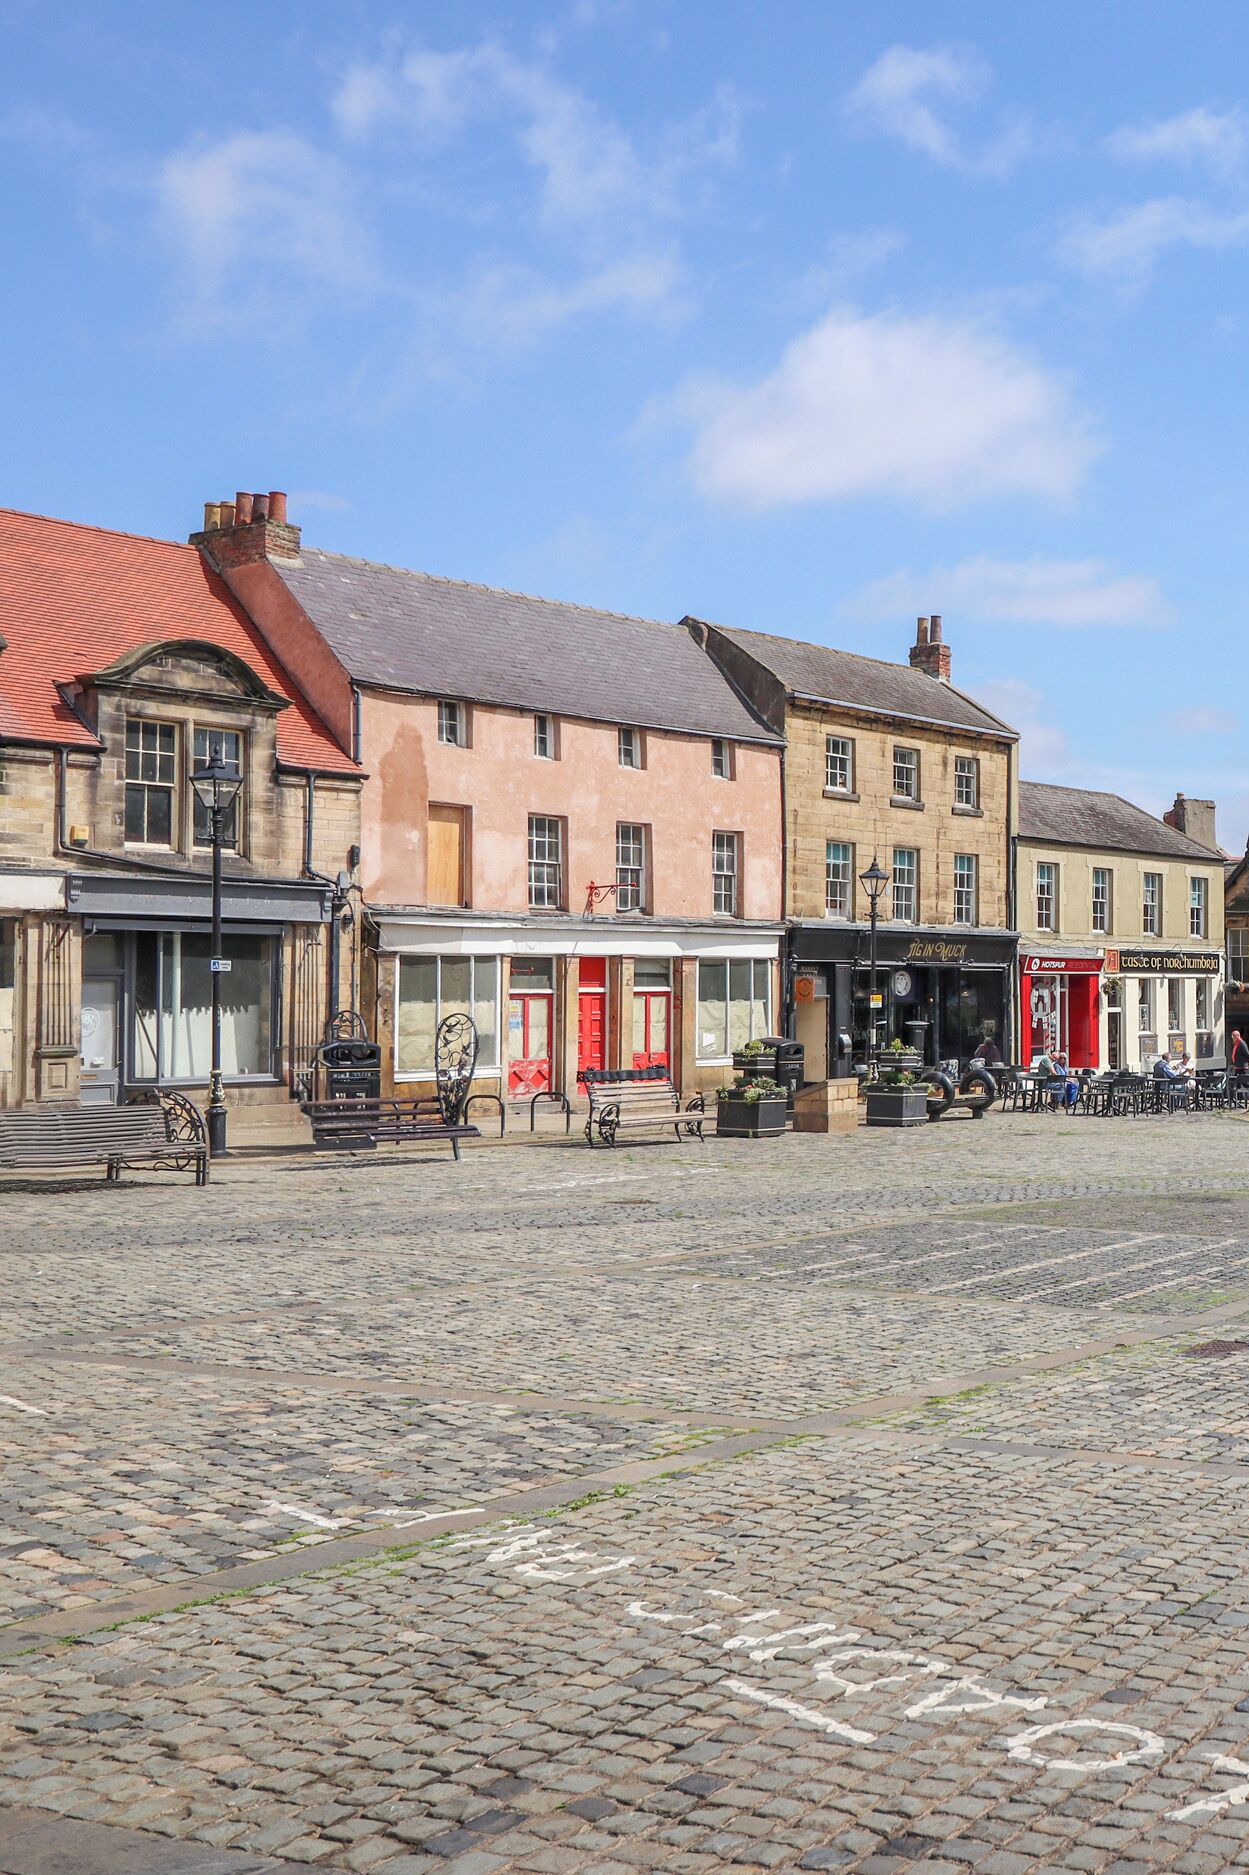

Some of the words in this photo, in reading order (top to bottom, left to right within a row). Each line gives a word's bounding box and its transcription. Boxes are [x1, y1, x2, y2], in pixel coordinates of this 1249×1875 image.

[907, 938, 923, 958] PIG
[923, 943, 934, 957] IN
[934, 942, 968, 960] MUCK
[1040, 960, 1066, 969] HOTSPUR
